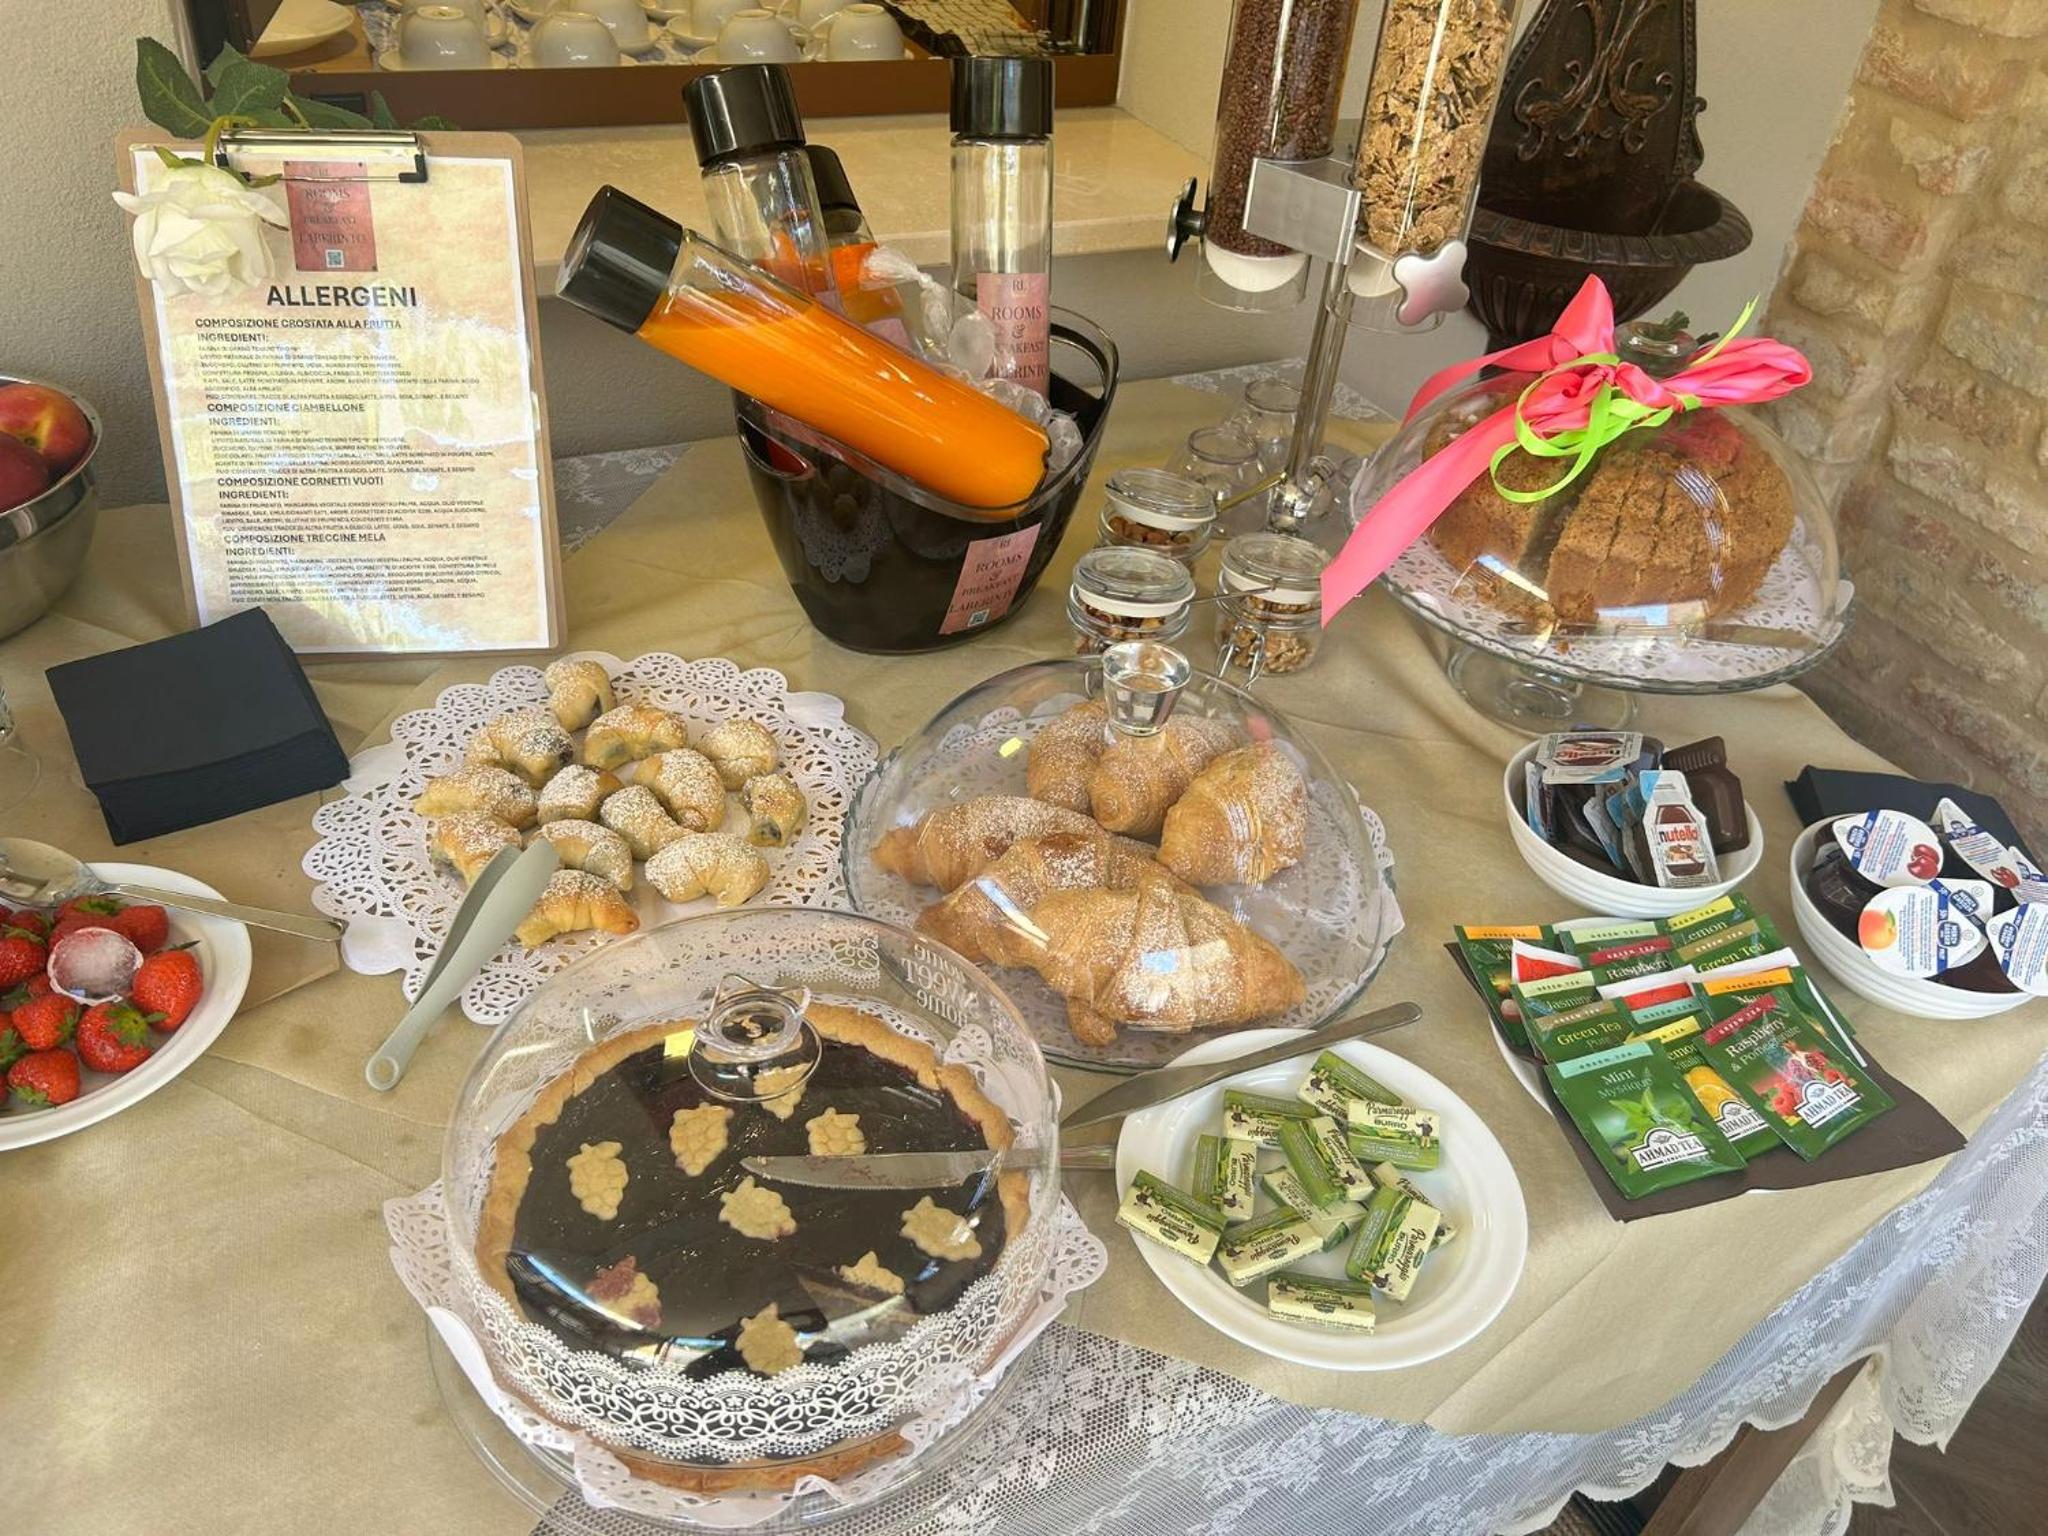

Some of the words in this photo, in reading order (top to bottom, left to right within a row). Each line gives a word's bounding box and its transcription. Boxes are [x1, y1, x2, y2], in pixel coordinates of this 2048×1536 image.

[266, 285, 417, 308] ALLERGENI
[991, 306, 1042, 320] ROOMS
[195, 318, 279, 328] COMPOSIZIONE
[281, 318, 334, 328] CROSTATA
[336, 319, 361, 328] ALLA
[364, 320, 402, 329] FRUTTA
[197, 332, 269, 342] INGREDIENTI:
[207, 403, 291, 412] COMPOSIZIONE
[292, 403, 365, 412] CIAMBELLONE
[218, 477, 299, 487] COMPOSIZIONE
[301, 476, 350, 486] CORNETTI
[352, 476, 384, 486] VUOTI
[219, 490, 289, 500] INGREDIENTI:
[224, 534, 304, 544] COMPOSIZIONE
[308, 534, 357, 542] TRECCINE
[358, 532, 386, 542] MELA
[226, 547, 295, 556] INGREDIENTI:
[1658, 826, 1698, 843] nutella
[1681, 920, 1728, 944] Lemon
[1699, 953, 1740, 972] Green
[1740, 942, 1766, 956] Tea
[1557, 1027, 1598, 1046] Green
[1598, 1022, 1622, 1033] Tea
[1725, 1018, 1786, 1058] Raspberry
[1602, 1068, 1636, 1086] Mint
[1366, 1101, 1416, 1120] Parmareggio
[1803, 1094, 1837, 1120] AHMAD
[1834, 1086, 1854, 1100] TEA
[1374, 1117, 1408, 1130] BURRO
[1640, 1144, 1680, 1164] AHMAD
[1680, 1138, 1702, 1150] TEA
[1146, 1214, 1200, 1245] Parmareggio
[1387, 1232, 1406, 1264] BURRO
[1396, 1228, 1426, 1282] Parmareggio
